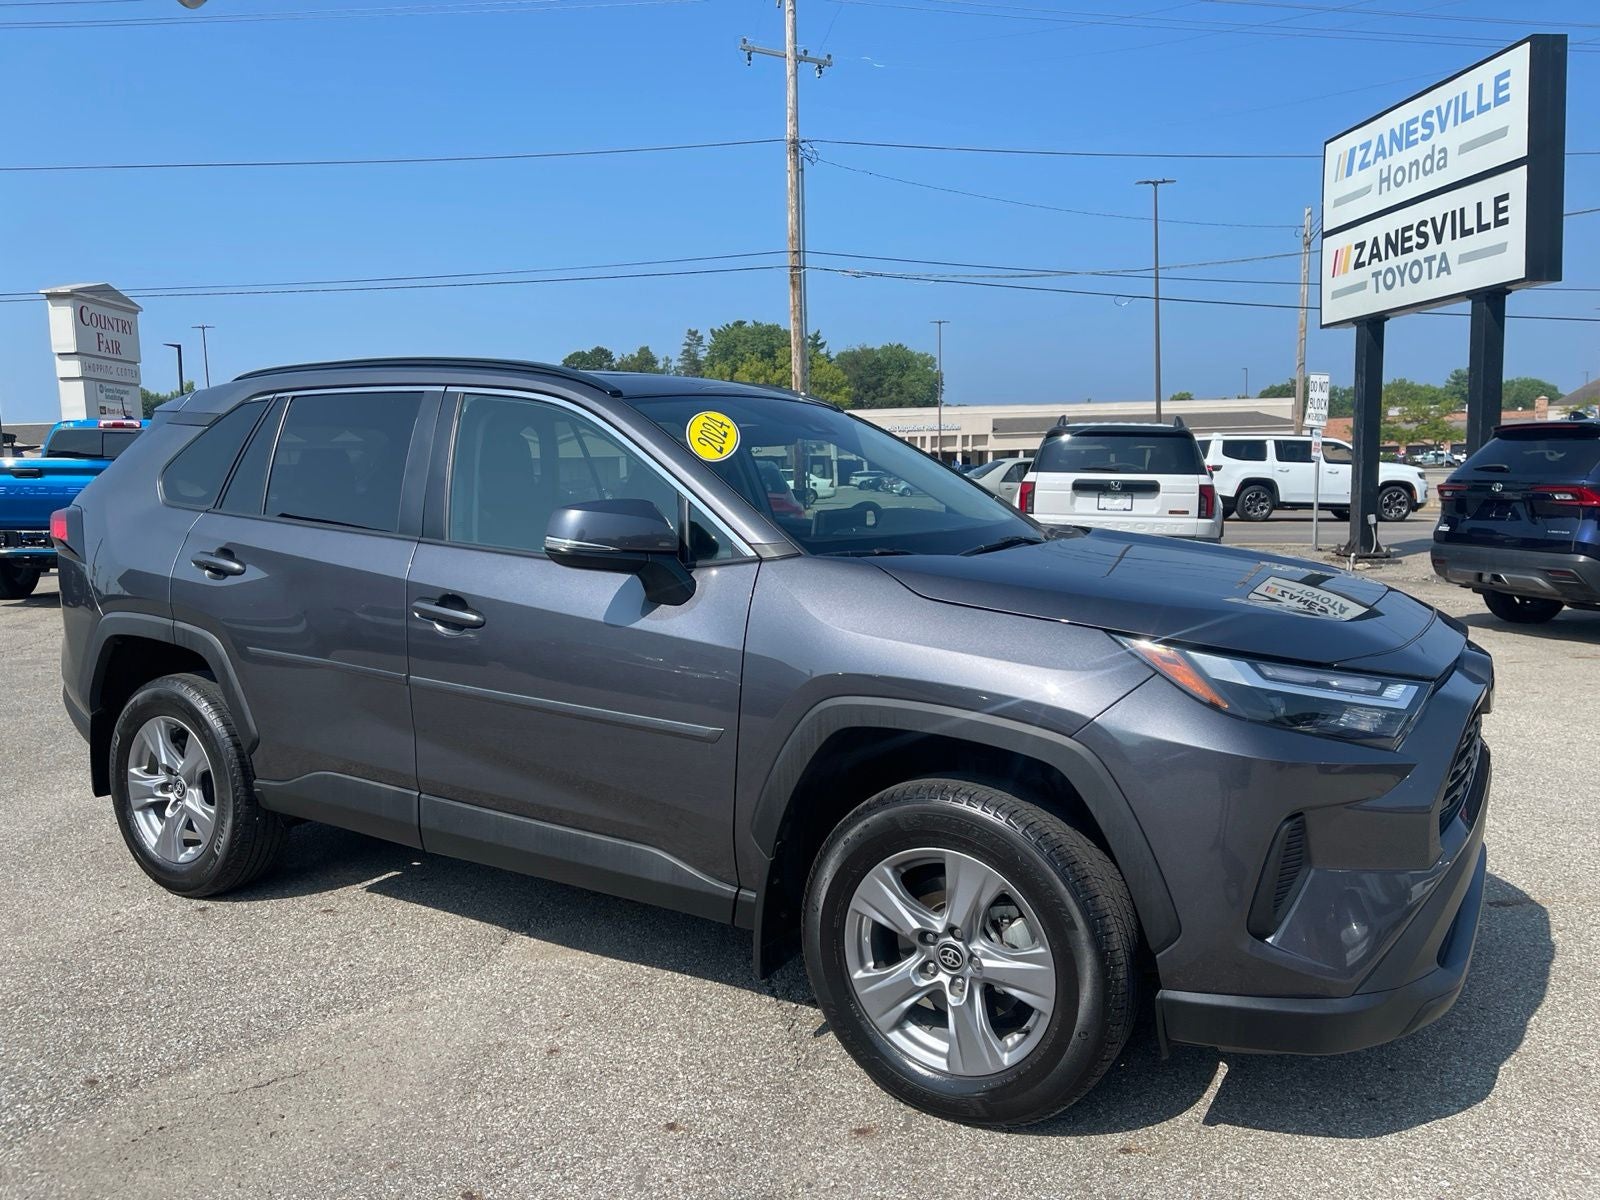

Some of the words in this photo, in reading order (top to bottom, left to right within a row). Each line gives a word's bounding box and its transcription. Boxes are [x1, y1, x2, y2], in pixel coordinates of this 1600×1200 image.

[1358, 69, 1511, 172] ZANESVILLE
[1379, 144, 1448, 195] Honda
[1353, 192, 1510, 270] ZANESVILLE
[1371, 251, 1452, 294] TOYOTA
[80, 305, 133, 335] COUNTRY
[96, 332, 121, 355] FAIR
[84, 361, 113, 376] SHOPPING
[116, 367, 138, 379] CENTER
[1310, 381, 1318, 393] DO
[1319, 381, 1329, 393] NOT
[1309, 398, 1328, 410] BLOCK
[698, 415, 731, 454] 2024
[926, 423, 961, 431] Rehailitation
